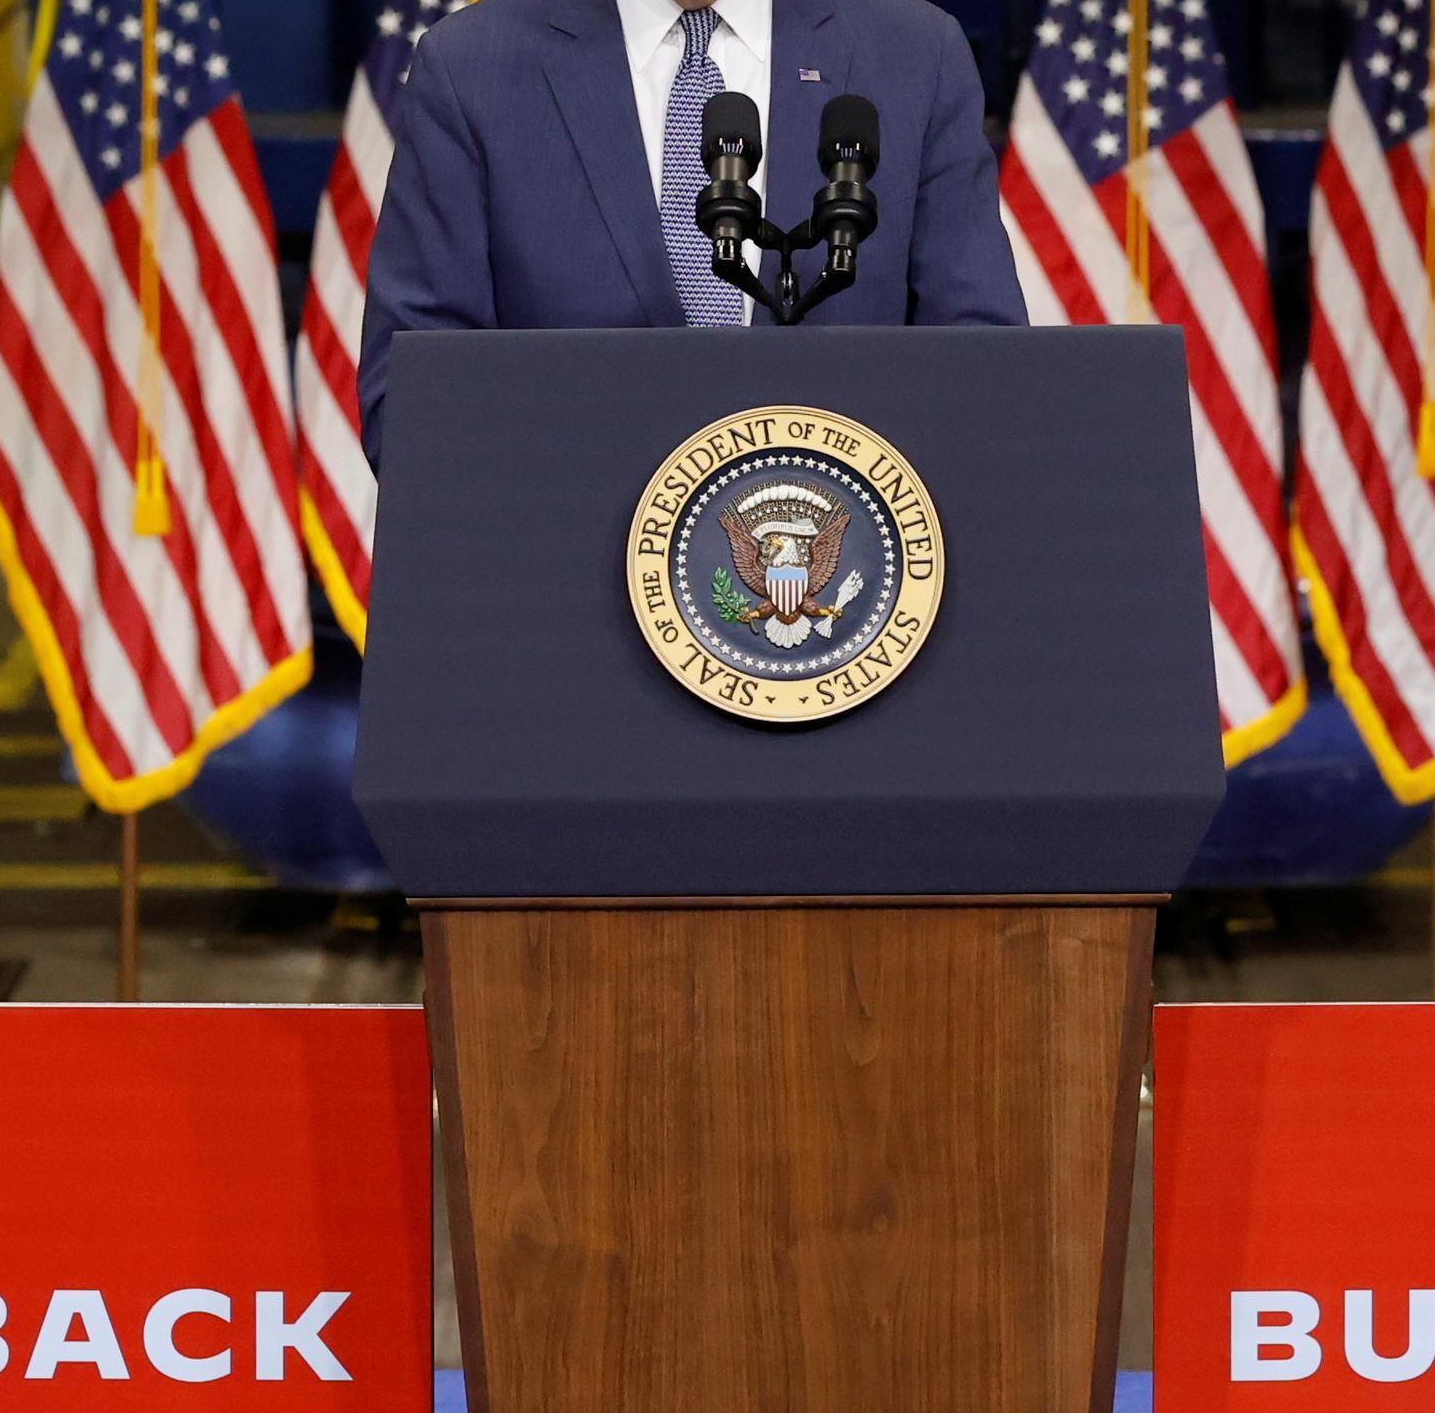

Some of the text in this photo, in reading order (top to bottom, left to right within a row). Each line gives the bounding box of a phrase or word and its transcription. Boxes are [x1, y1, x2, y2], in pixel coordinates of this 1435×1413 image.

[638, 418, 934, 707] SEAL OF THE PRESIDENT OF THE UNITED STATES
